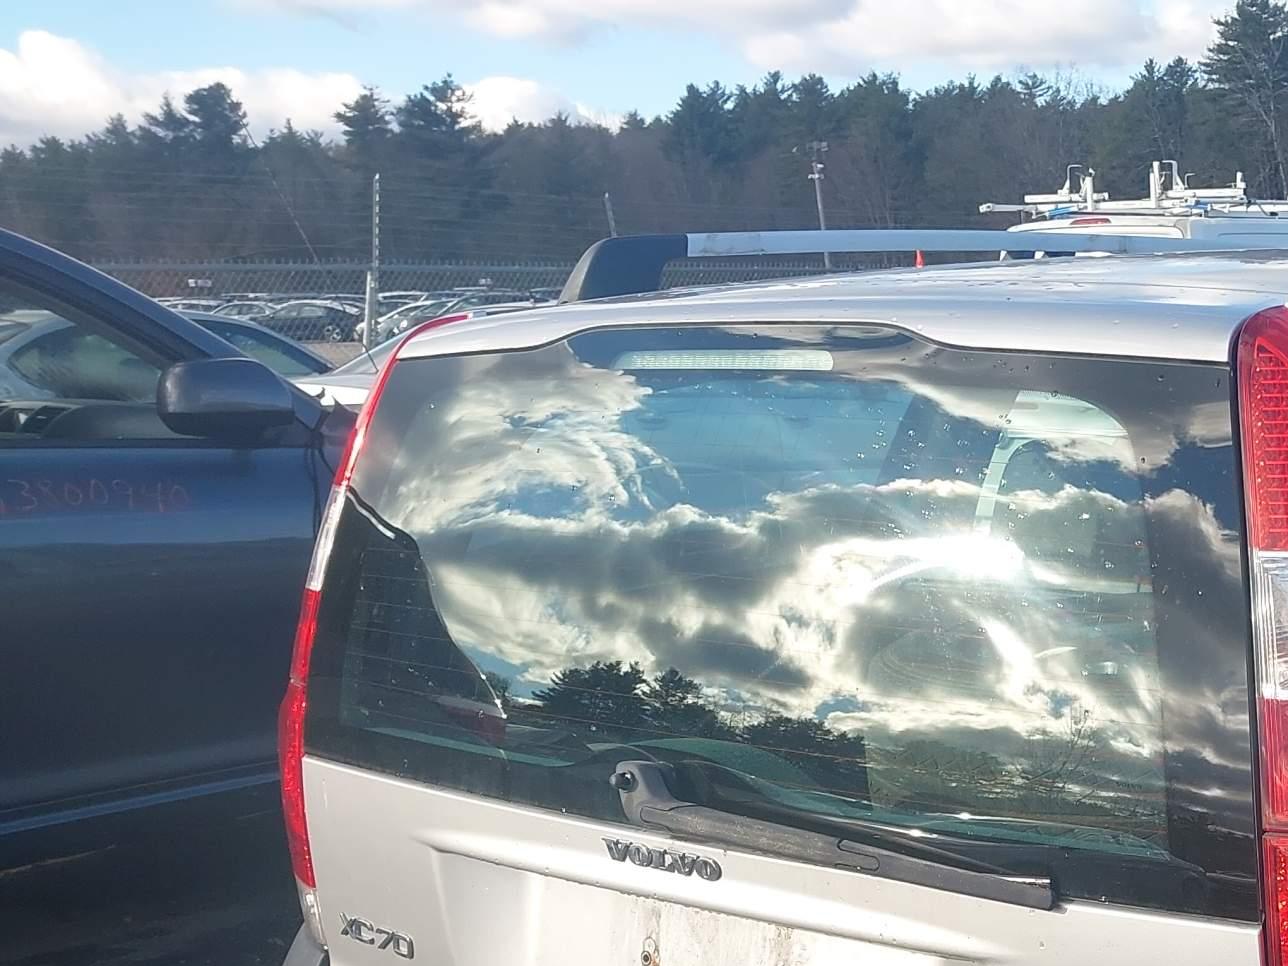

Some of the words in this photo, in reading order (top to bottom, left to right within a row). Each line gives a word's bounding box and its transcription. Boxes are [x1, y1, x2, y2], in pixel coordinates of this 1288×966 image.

[0, 478, 191, 513] 3800940
[602, 837, 723, 882] VOLVO
[338, 911, 415, 960] XC70
